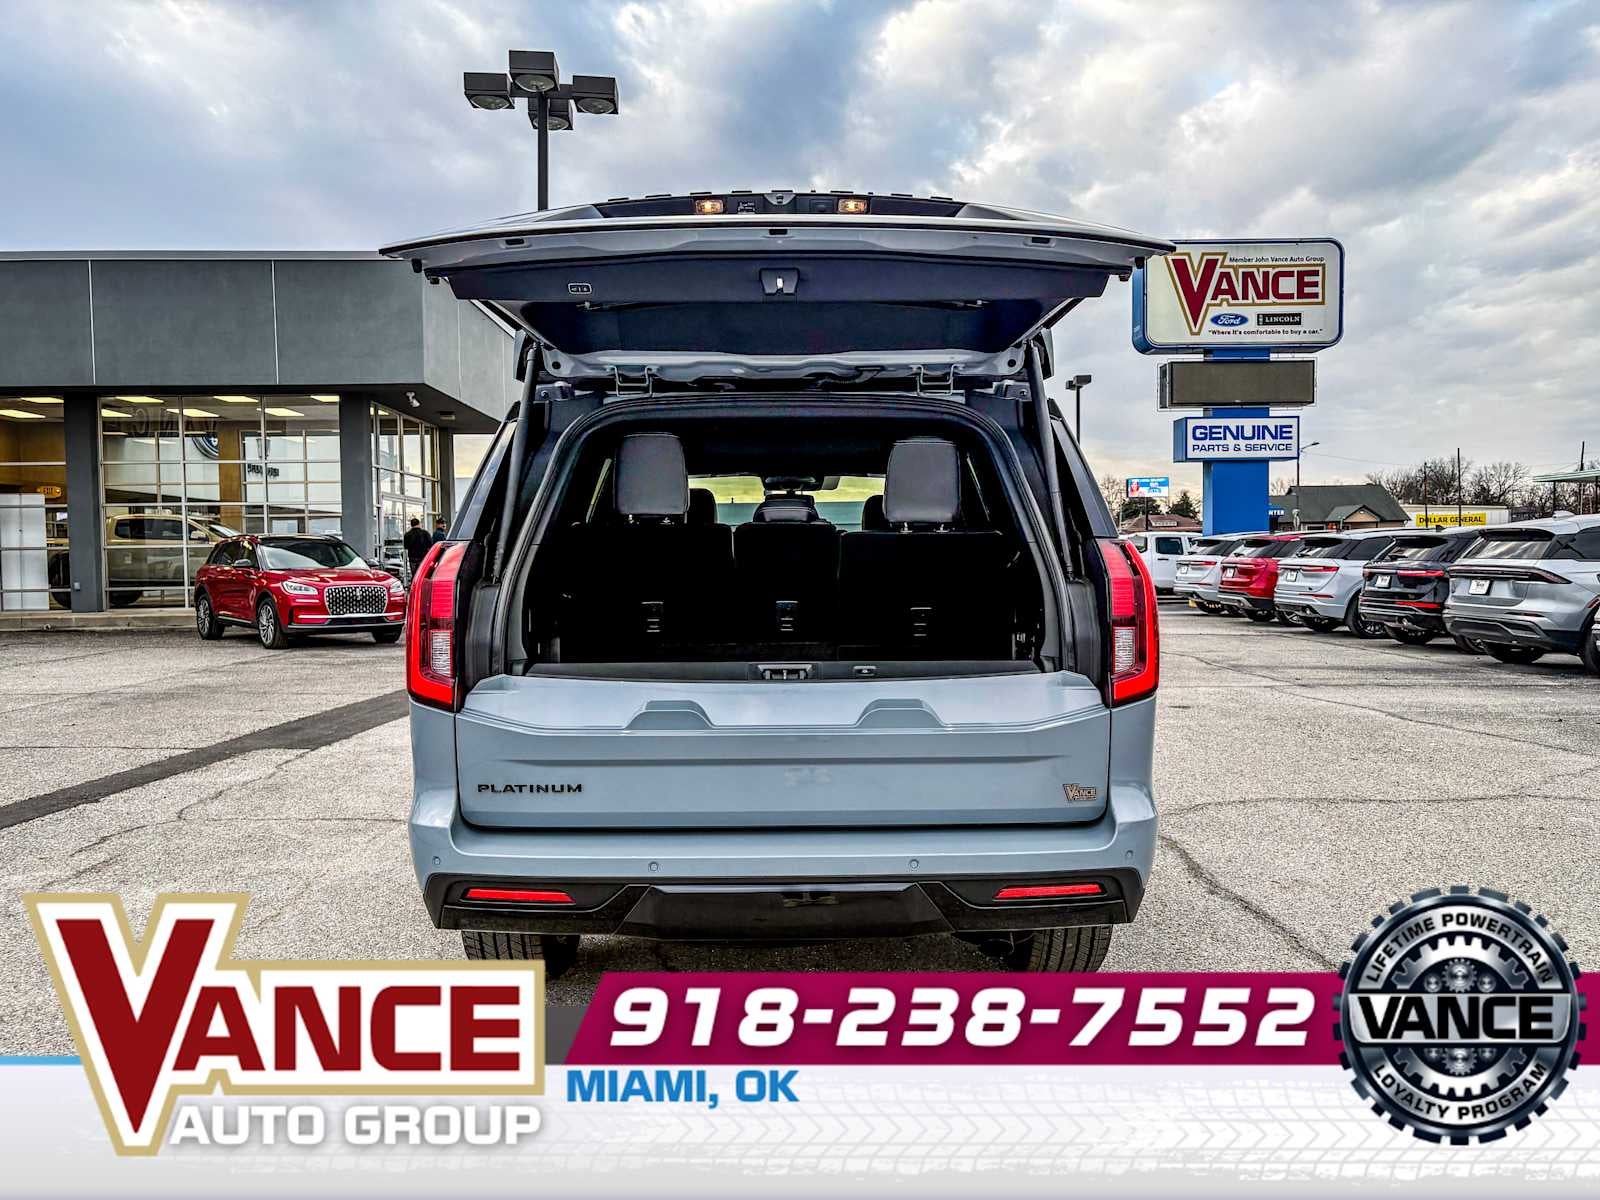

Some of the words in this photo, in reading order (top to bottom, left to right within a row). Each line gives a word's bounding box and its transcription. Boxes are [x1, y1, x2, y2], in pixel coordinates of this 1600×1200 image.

[1305, 255, 1325, 263] Group
[1171, 258, 1320, 329] VANCE
[1217, 314, 1242, 325] Ford
[1264, 315, 1300, 323] LINCOLN
[1290, 328, 1301, 336] buy
[1192, 424, 1293, 440] GENUINE
[1192, 443, 1230, 452] PARTS
[1233, 443, 1241, 452] &
[1244, 443, 1292, 451] SERVICE
[477, 784, 582, 793] PLATINUM
[1063, 783, 1096, 801] VANCE
